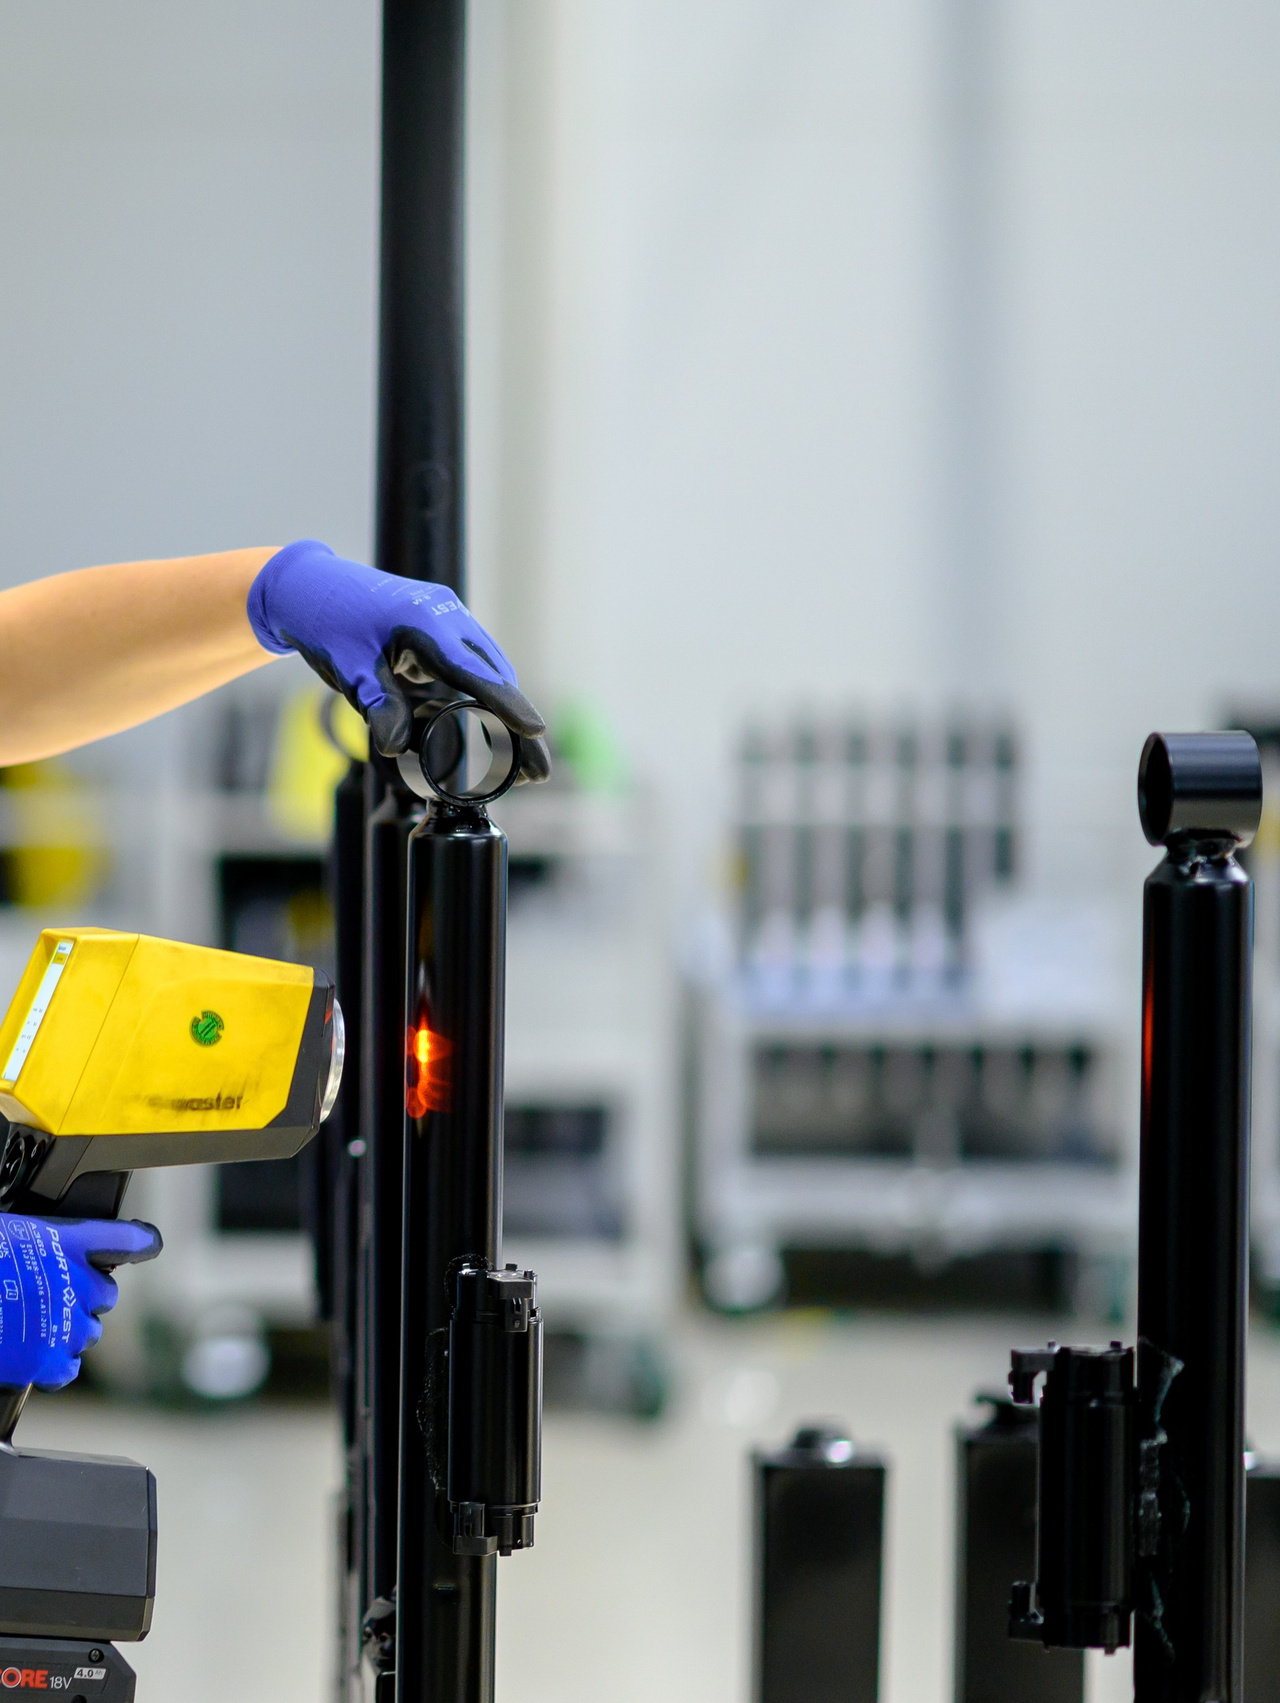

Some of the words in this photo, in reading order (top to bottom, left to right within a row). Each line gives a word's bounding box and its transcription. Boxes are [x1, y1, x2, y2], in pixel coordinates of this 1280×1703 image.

[30, 1221, 47, 1258] A360
[46, 1226, 76, 1344] PORTWEST
[76, 1668, 94, 1678] 4.0
